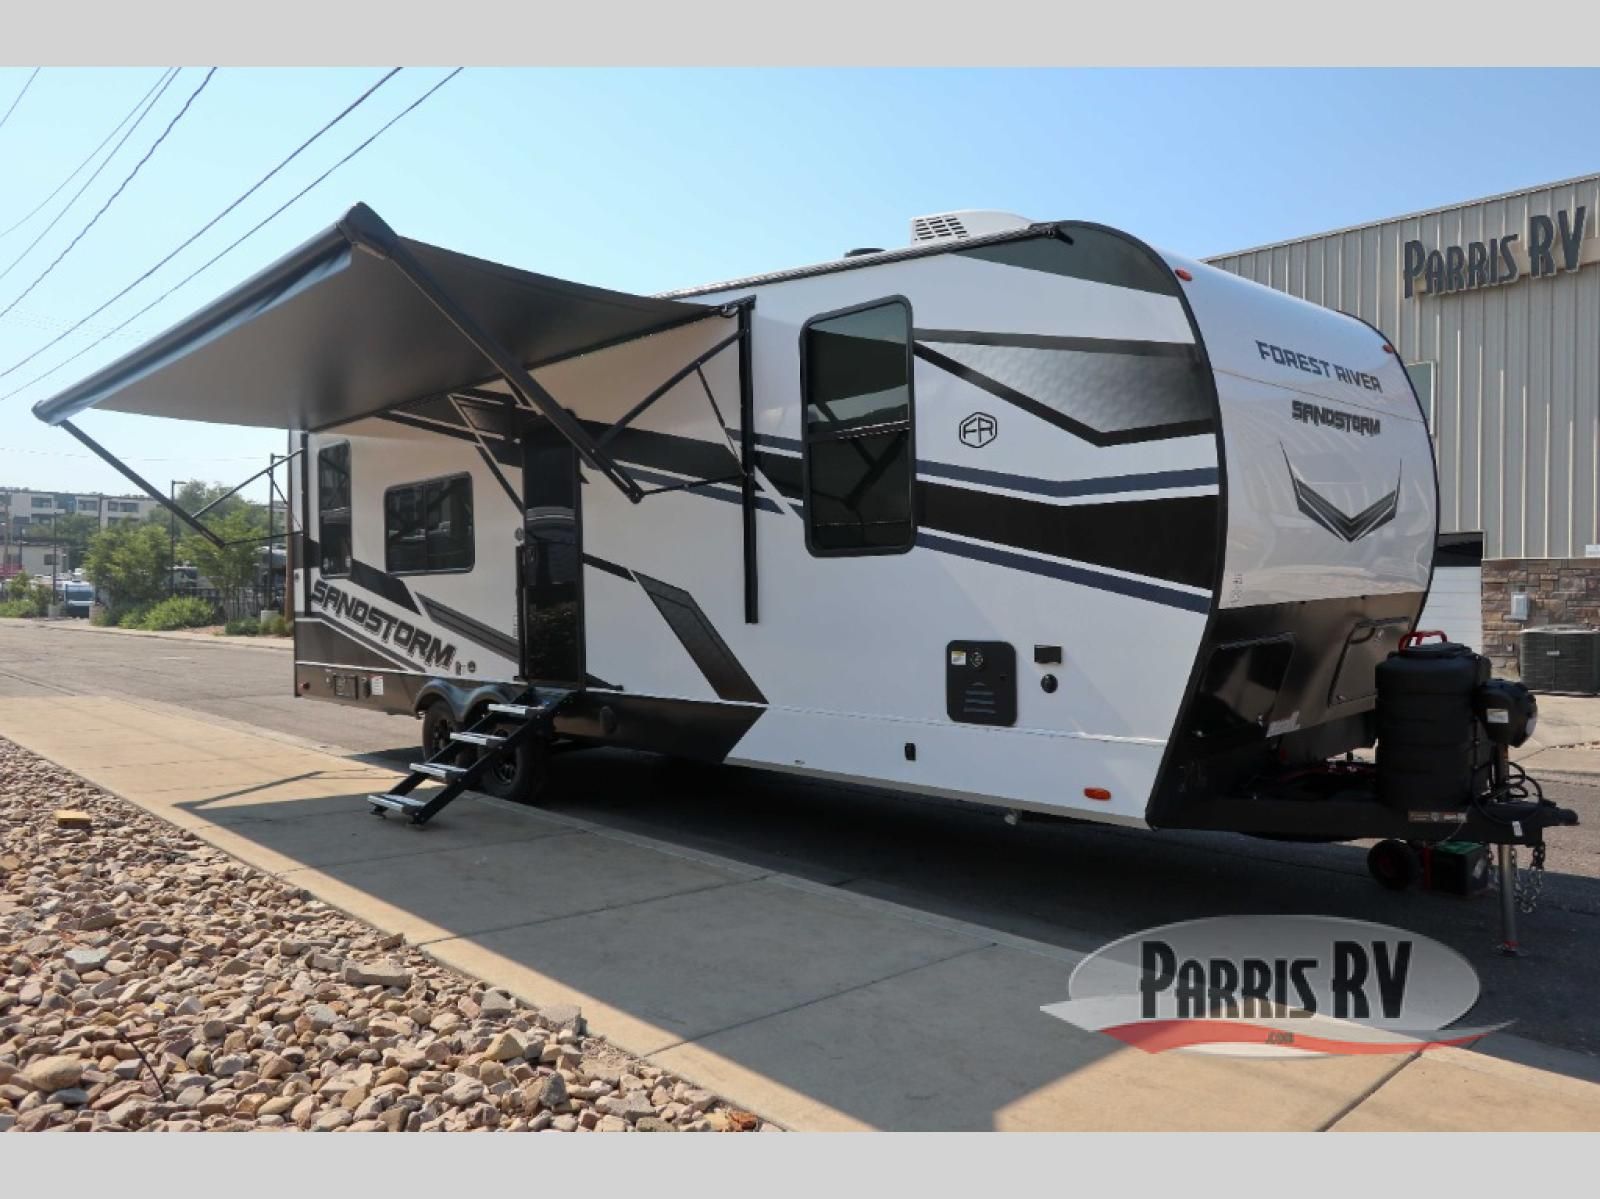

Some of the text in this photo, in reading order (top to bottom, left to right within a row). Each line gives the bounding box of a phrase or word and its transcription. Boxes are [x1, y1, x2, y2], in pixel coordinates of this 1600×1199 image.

[1529, 206, 1587, 277] RV
[1255, 339, 1383, 393] FOREST RIVER
[1291, 399, 1381, 437] SANDSTORM
[310, 578, 457, 671] SANDSTORM
